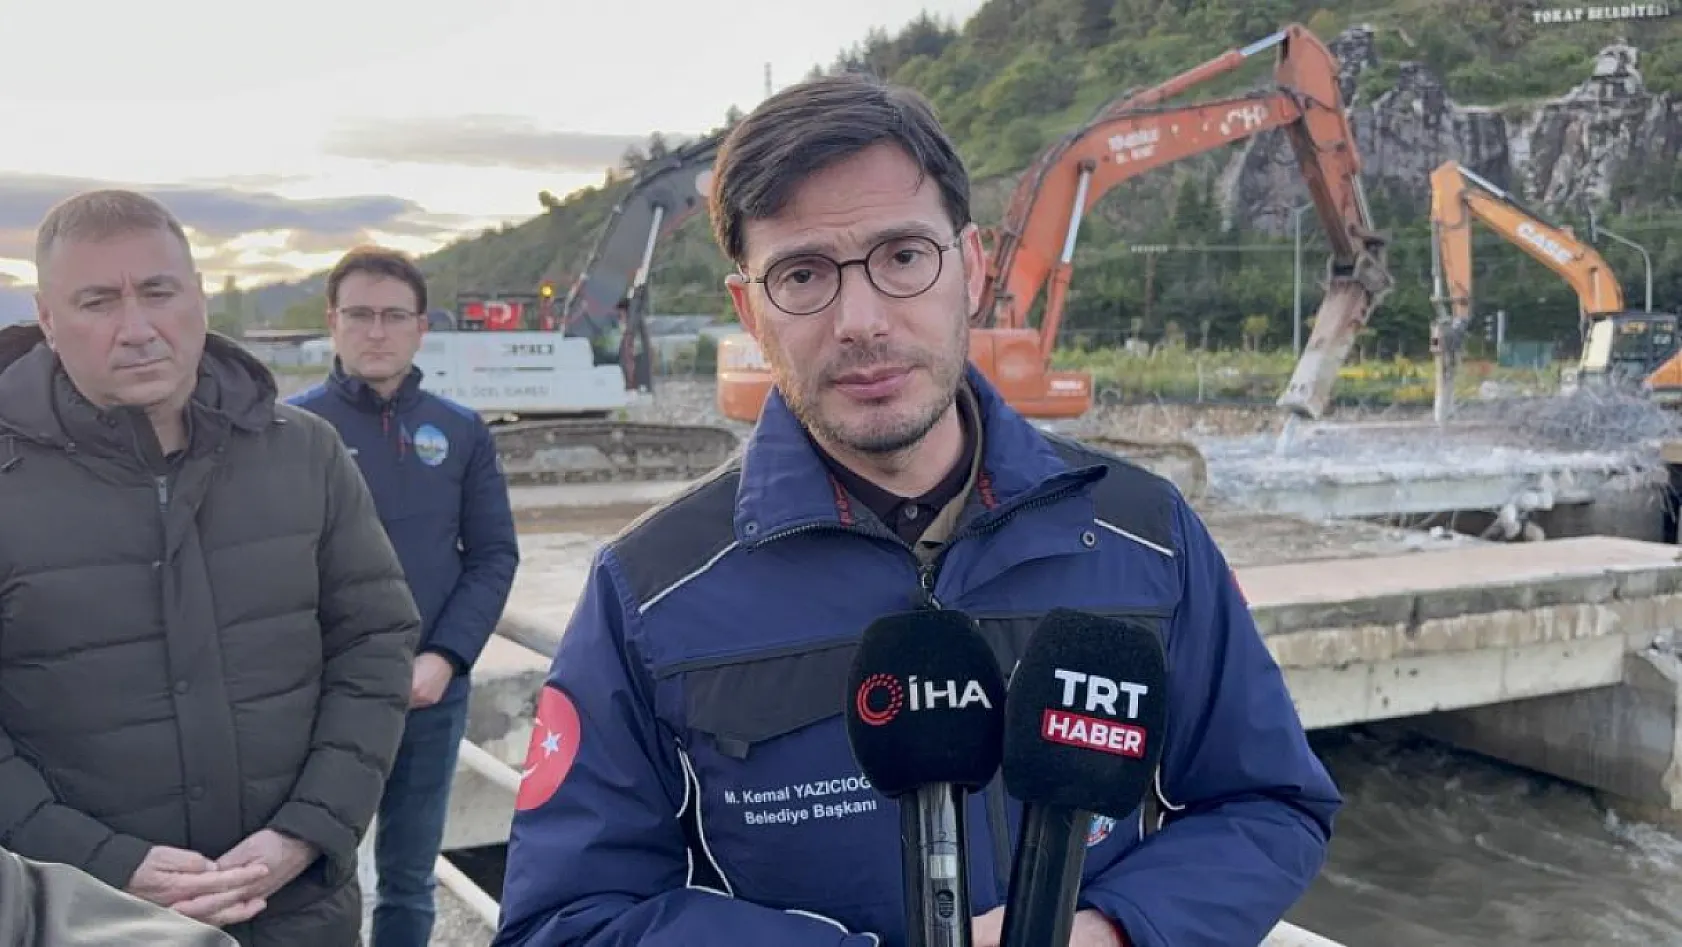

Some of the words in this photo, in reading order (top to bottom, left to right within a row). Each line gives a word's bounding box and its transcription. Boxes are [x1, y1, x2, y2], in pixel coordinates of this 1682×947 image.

[1532, 8, 1583, 23] TOKAT
[908, 675, 993, 711] İHA
[1054, 668, 1148, 719] TRT
[1047, 714, 1142, 753] HABER
[725, 790, 740, 804] M.
[743, 786, 790, 803] Kemal
[793, 772, 871, 798] YAZICIOĞ
[744, 808, 809, 825] Belediye
[812, 800, 877, 819] Başkanı
